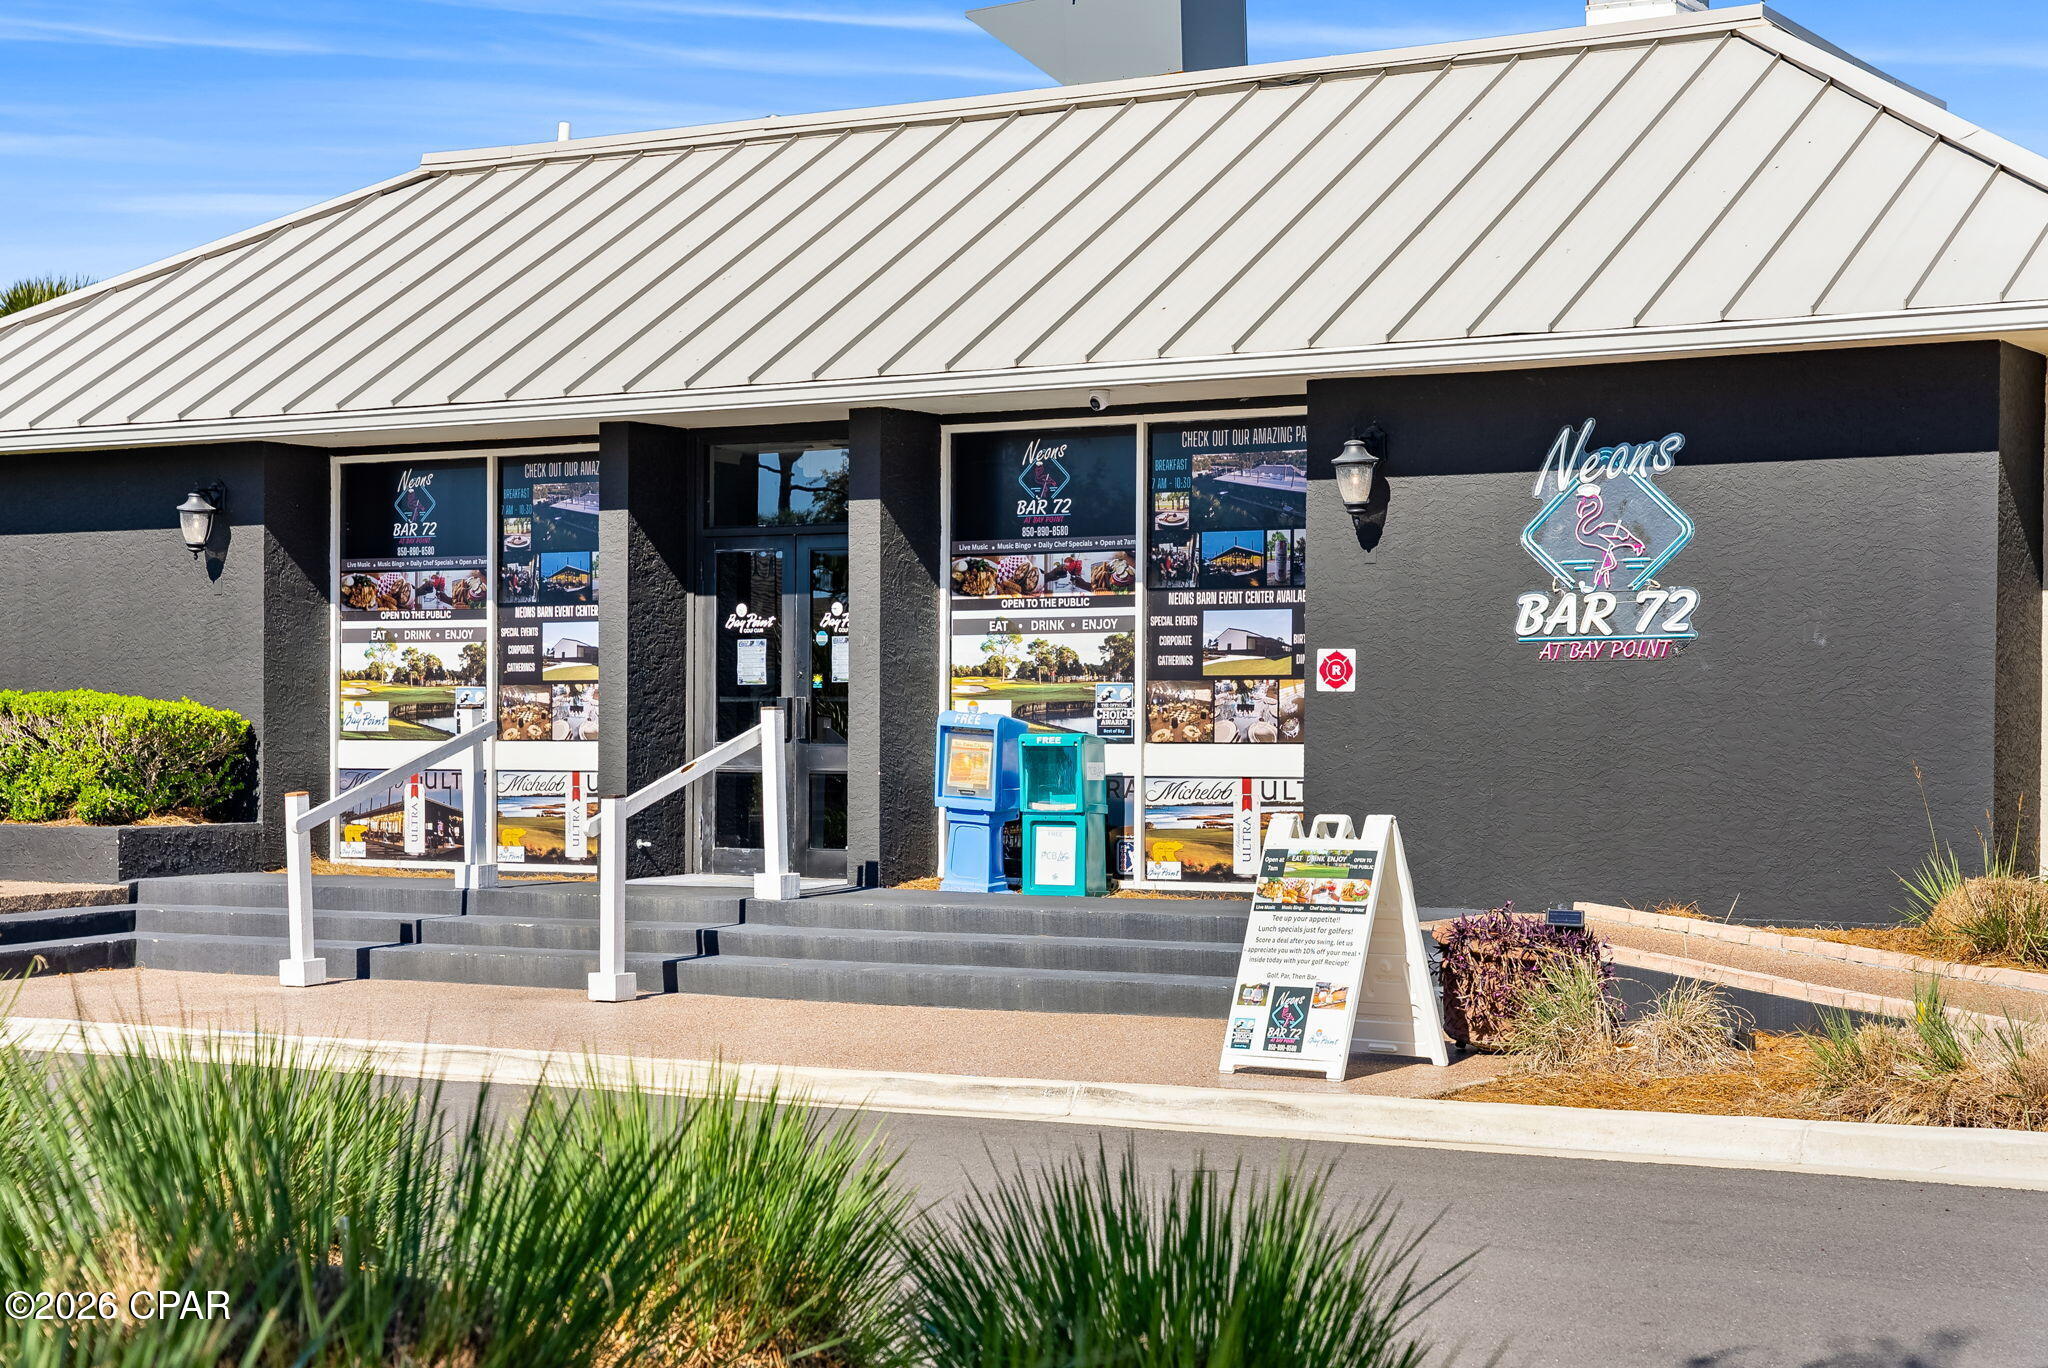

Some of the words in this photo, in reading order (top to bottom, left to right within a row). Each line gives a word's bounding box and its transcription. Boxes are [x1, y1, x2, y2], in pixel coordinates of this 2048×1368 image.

[1182, 431, 1209, 448] CHECK
[1212, 430, 1229, 446] OUT
[1232, 429, 1249, 445] OUR
[1253, 426, 1292, 444] AMAZING
[1022, 438, 1068, 466] Neons
[1534, 419, 1682, 496] Neons
[524, 463, 546, 478] CHECK
[549, 462, 562, 477] OUT
[564, 462, 578, 476] OUR
[1155, 458, 1187, 471] BREAKFAST
[398, 468, 433, 492] Neons
[1158, 478, 1167, 488] AM
[1174, 478, 1190, 488] 10:30
[504, 488, 530, 499] BREAKFAST
[1017, 500, 1048, 515] BAR
[1053, 498, 1072, 514] 72
[394, 522, 418, 536] BAR
[422, 522, 437, 535] 72
[1022, 526, 1068, 536] 850-890-8580
[1015, 542, 1031, 550] Bingo
[1069, 540, 1092, 548] Specials
[1001, 599, 1025, 608] OPEN
[1026, 599, 1038, 608] TO
[1039, 598, 1057, 607] THE
[1058, 598, 1090, 607] PUBLIC
[1168, 592, 1194, 605] NEONS
[1196, 592, 1217, 604] BARN
[1219, 591, 1243, 604] EVENT
[1246, 590, 1274, 603] CENTER
[380, 611, 399, 620] OPEN
[401, 611, 410, 619] TO
[411, 611, 425, 619] THE
[426, 610, 451, 619] PUBLIC
[515, 606, 536, 618] NEONS
[537, 606, 553, 618] BARN
[555, 605, 574, 617] EVENT
[576, 605, 598, 616] CENTER
[1516, 592, 1617, 636] BAR
[1636, 589, 1697, 633] 72
[989, 621, 1008, 632] EAT
[1031, 620, 1064, 630] DRINK
[1082, 619, 1118, 630] ENJOY
[1150, 616, 1174, 626] SPECIAL
[1175, 615, 1197, 626] EVENTS
[371, 630, 387, 640] EAT
[404, 630, 431, 640] DRINK
[445, 629, 474, 639] ENJOY
[521, 627, 538, 636] EVENTS
[1159, 635, 1192, 646] CORPORATE
[1539, 641, 1566, 660] AT
[1569, 640, 1608, 659] BAY
[1610, 639, 1672, 659] POINT
[1158, 655, 1193, 666] GATHERINGS
[1332, 665, 1341, 675] R
[955, 714, 982, 725] FREE
[1094, 708, 1135, 720] CHOICE
[498, 773, 567, 794] Michelob
[1146, 780, 1236, 801] Michelob
[411, 802, 419, 843] ULTRA
[1243, 817, 1251, 862] ULTRA
[1278, 926, 1302, 934] specials
[1328, 928, 1353, 936] golfers!
[1267, 956, 1282, 964] today
[1276, 991, 1305, 1007] Neons
[1267, 1027, 1287, 1038] BAR
[1290, 1028, 1302, 1038] 72
